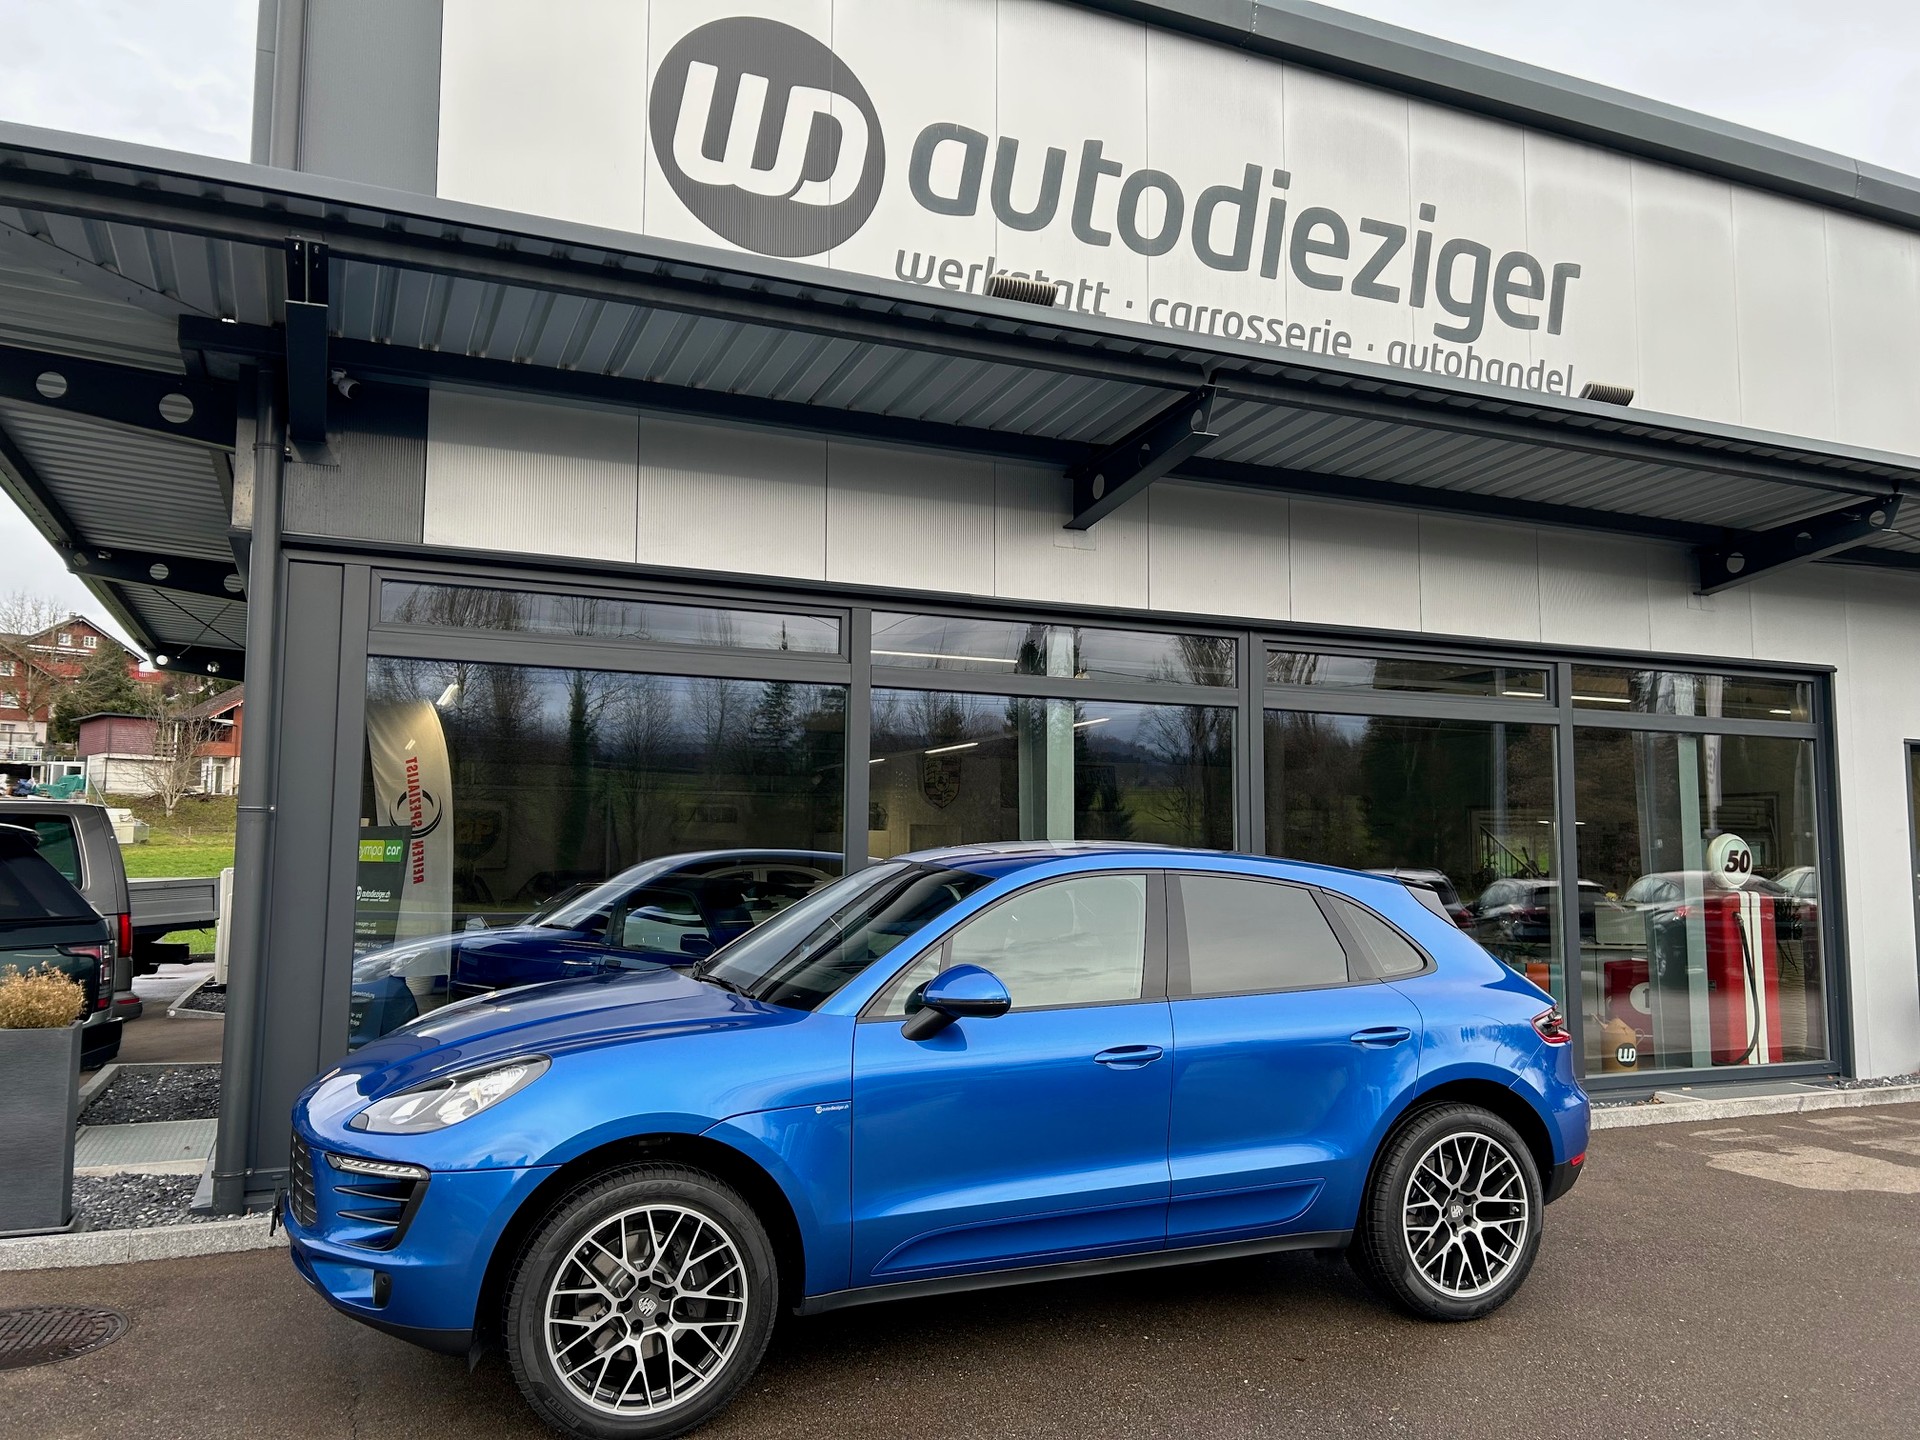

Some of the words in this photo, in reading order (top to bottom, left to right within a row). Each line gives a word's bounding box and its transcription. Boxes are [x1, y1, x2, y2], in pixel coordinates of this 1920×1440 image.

[908, 122, 1581, 343] autodieziger
[895, 249, 1110, 316] werkatt
[1149, 298, 1351, 358] carrosserie
[1387, 340, 1573, 397] autohandel
[359, 845, 383, 859] ympa
[386, 845, 401, 856] car
[1724, 850, 1750, 873] 50
